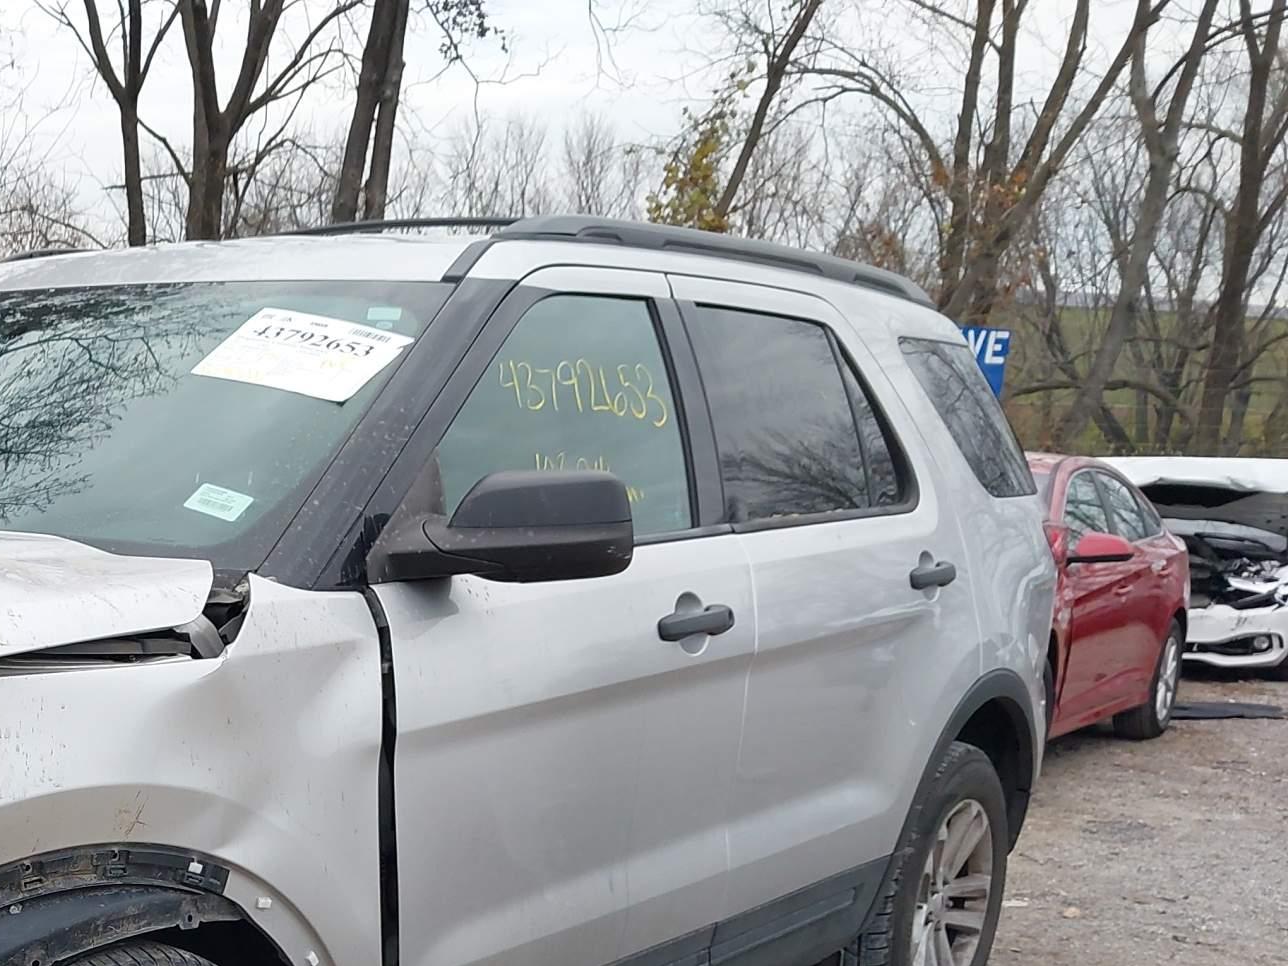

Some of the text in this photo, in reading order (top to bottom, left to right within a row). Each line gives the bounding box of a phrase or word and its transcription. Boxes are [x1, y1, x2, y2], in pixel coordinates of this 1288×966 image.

[253, 325, 375, 357] 43792653
[960, 329, 1011, 365] VE
[499, 358, 668, 427] 43792653
